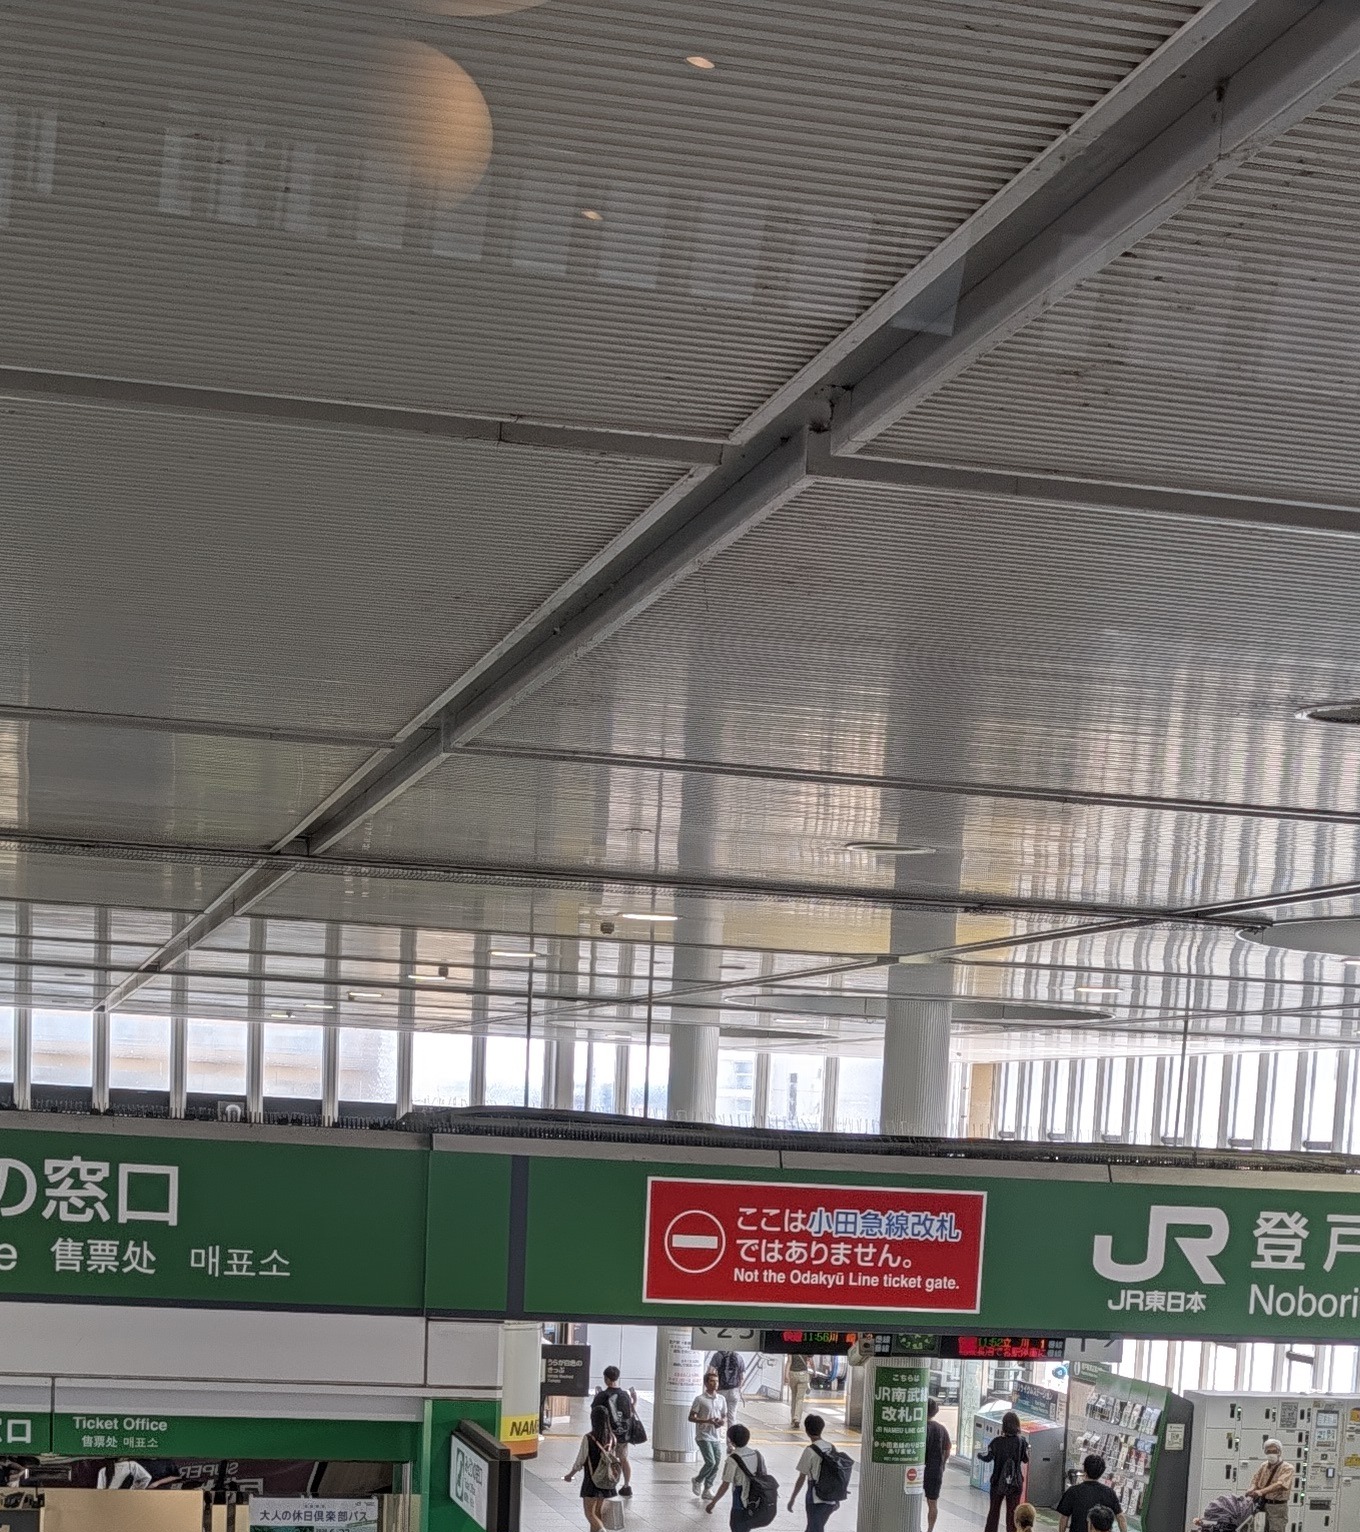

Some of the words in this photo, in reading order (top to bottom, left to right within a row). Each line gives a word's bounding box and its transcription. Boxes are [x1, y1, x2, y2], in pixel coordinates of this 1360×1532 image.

[737, 1206, 961, 1242] ここは小田急線改札
[50, 1236, 157, 1275] 售票处
[736, 1239, 912, 1269] ではありません。
[1092, 1205, 1229, 1285] JR
[190, 1245, 291, 1278] 매표소
[734, 1269, 761, 1283] Not
[763, 1270, 786, 1284] the
[790, 1271, 845, 1289] Odakyū
[849, 1273, 880, 1287] Line
[883, 1274, 923, 1289] ticket
[925, 1277, 960, 1292] gate.
[1108, 1290, 1207, 1314] JR東日本
[893, 1374, 920, 1382] こちらは
[72, 1416, 118, 1432] Ticket
[122, 1417, 167, 1433] Office
[881, 1406, 924, 1422] 改札口
[122, 1435, 159, 1450] 매표소
